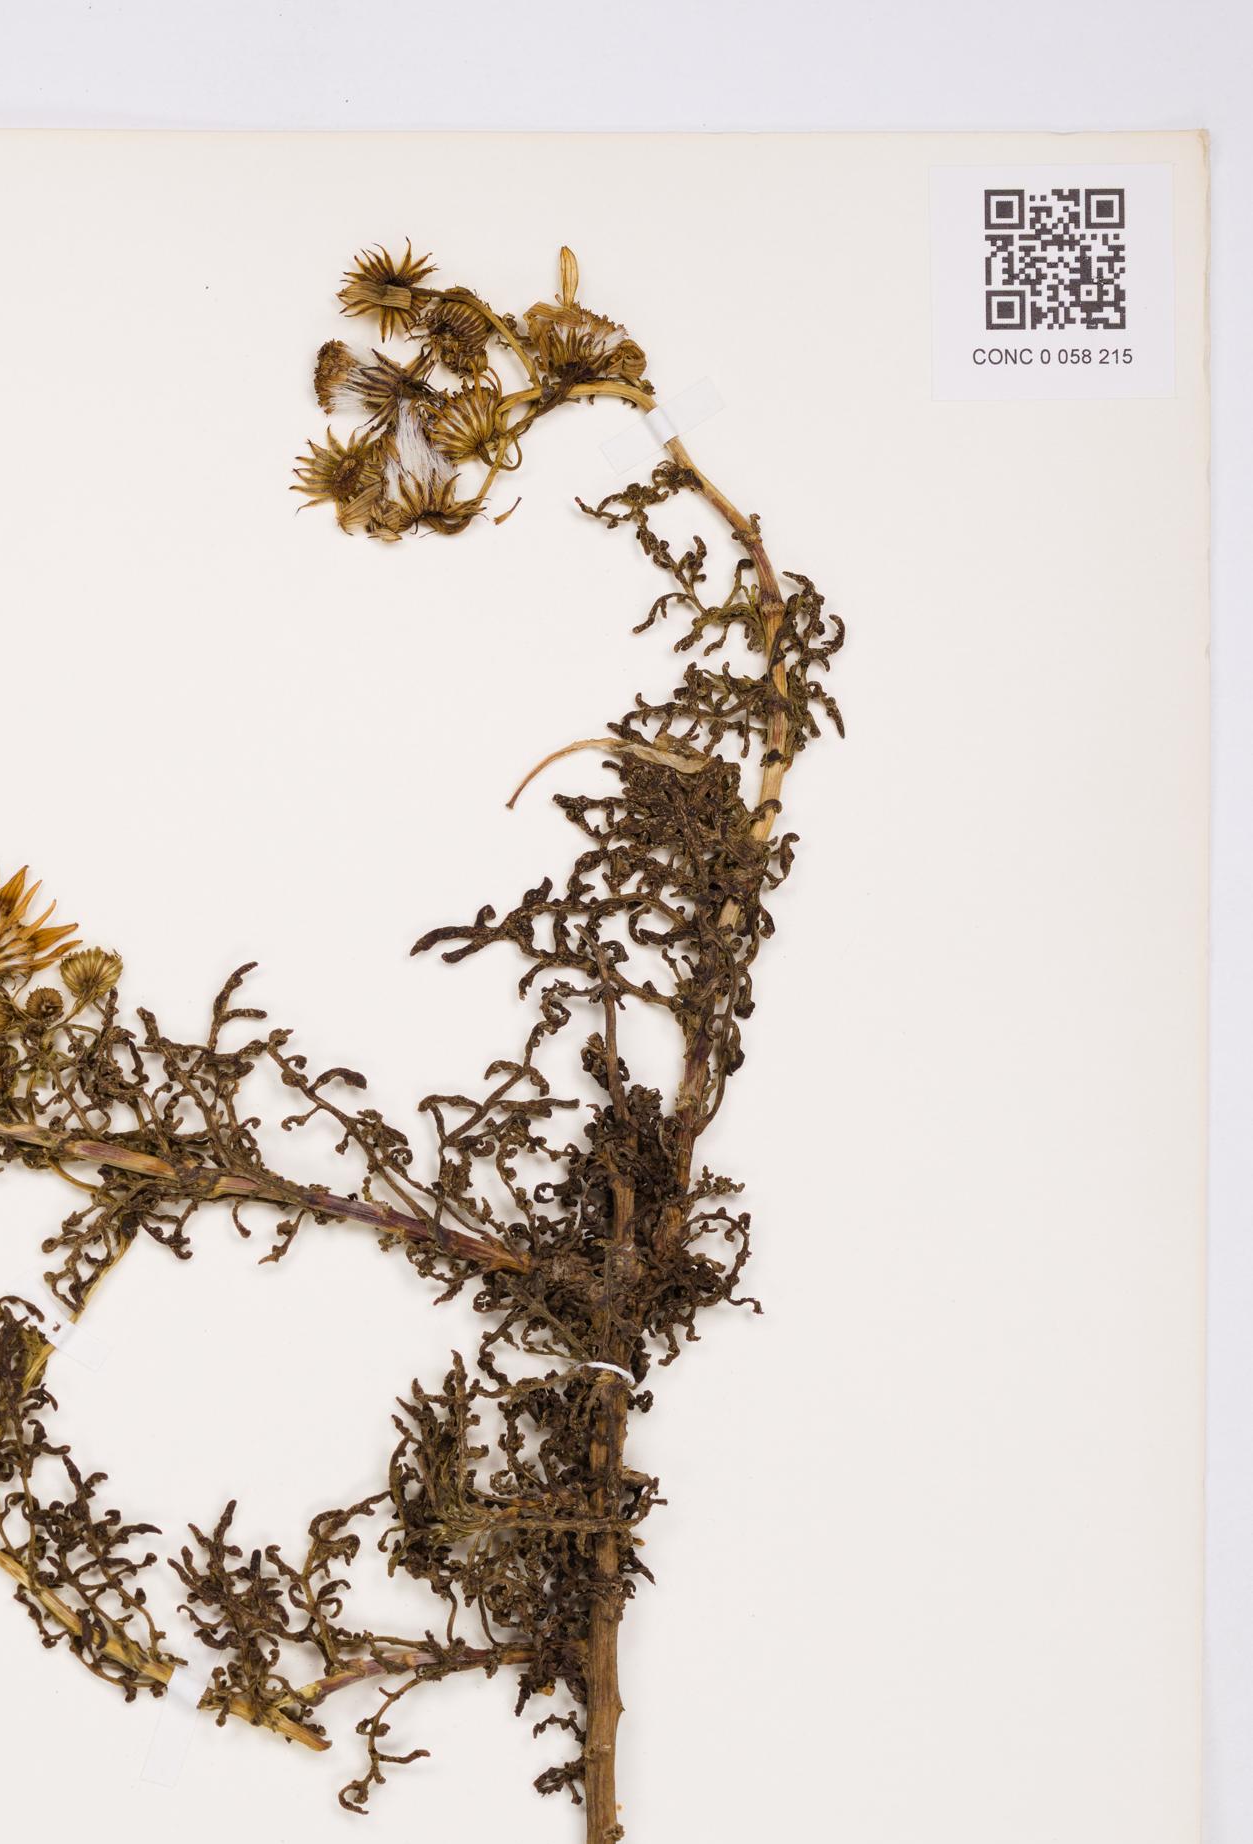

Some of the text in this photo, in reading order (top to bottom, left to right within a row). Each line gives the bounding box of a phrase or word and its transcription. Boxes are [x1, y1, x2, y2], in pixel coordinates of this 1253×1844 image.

[972, 348, 1133, 365] CONC 0 058 215
